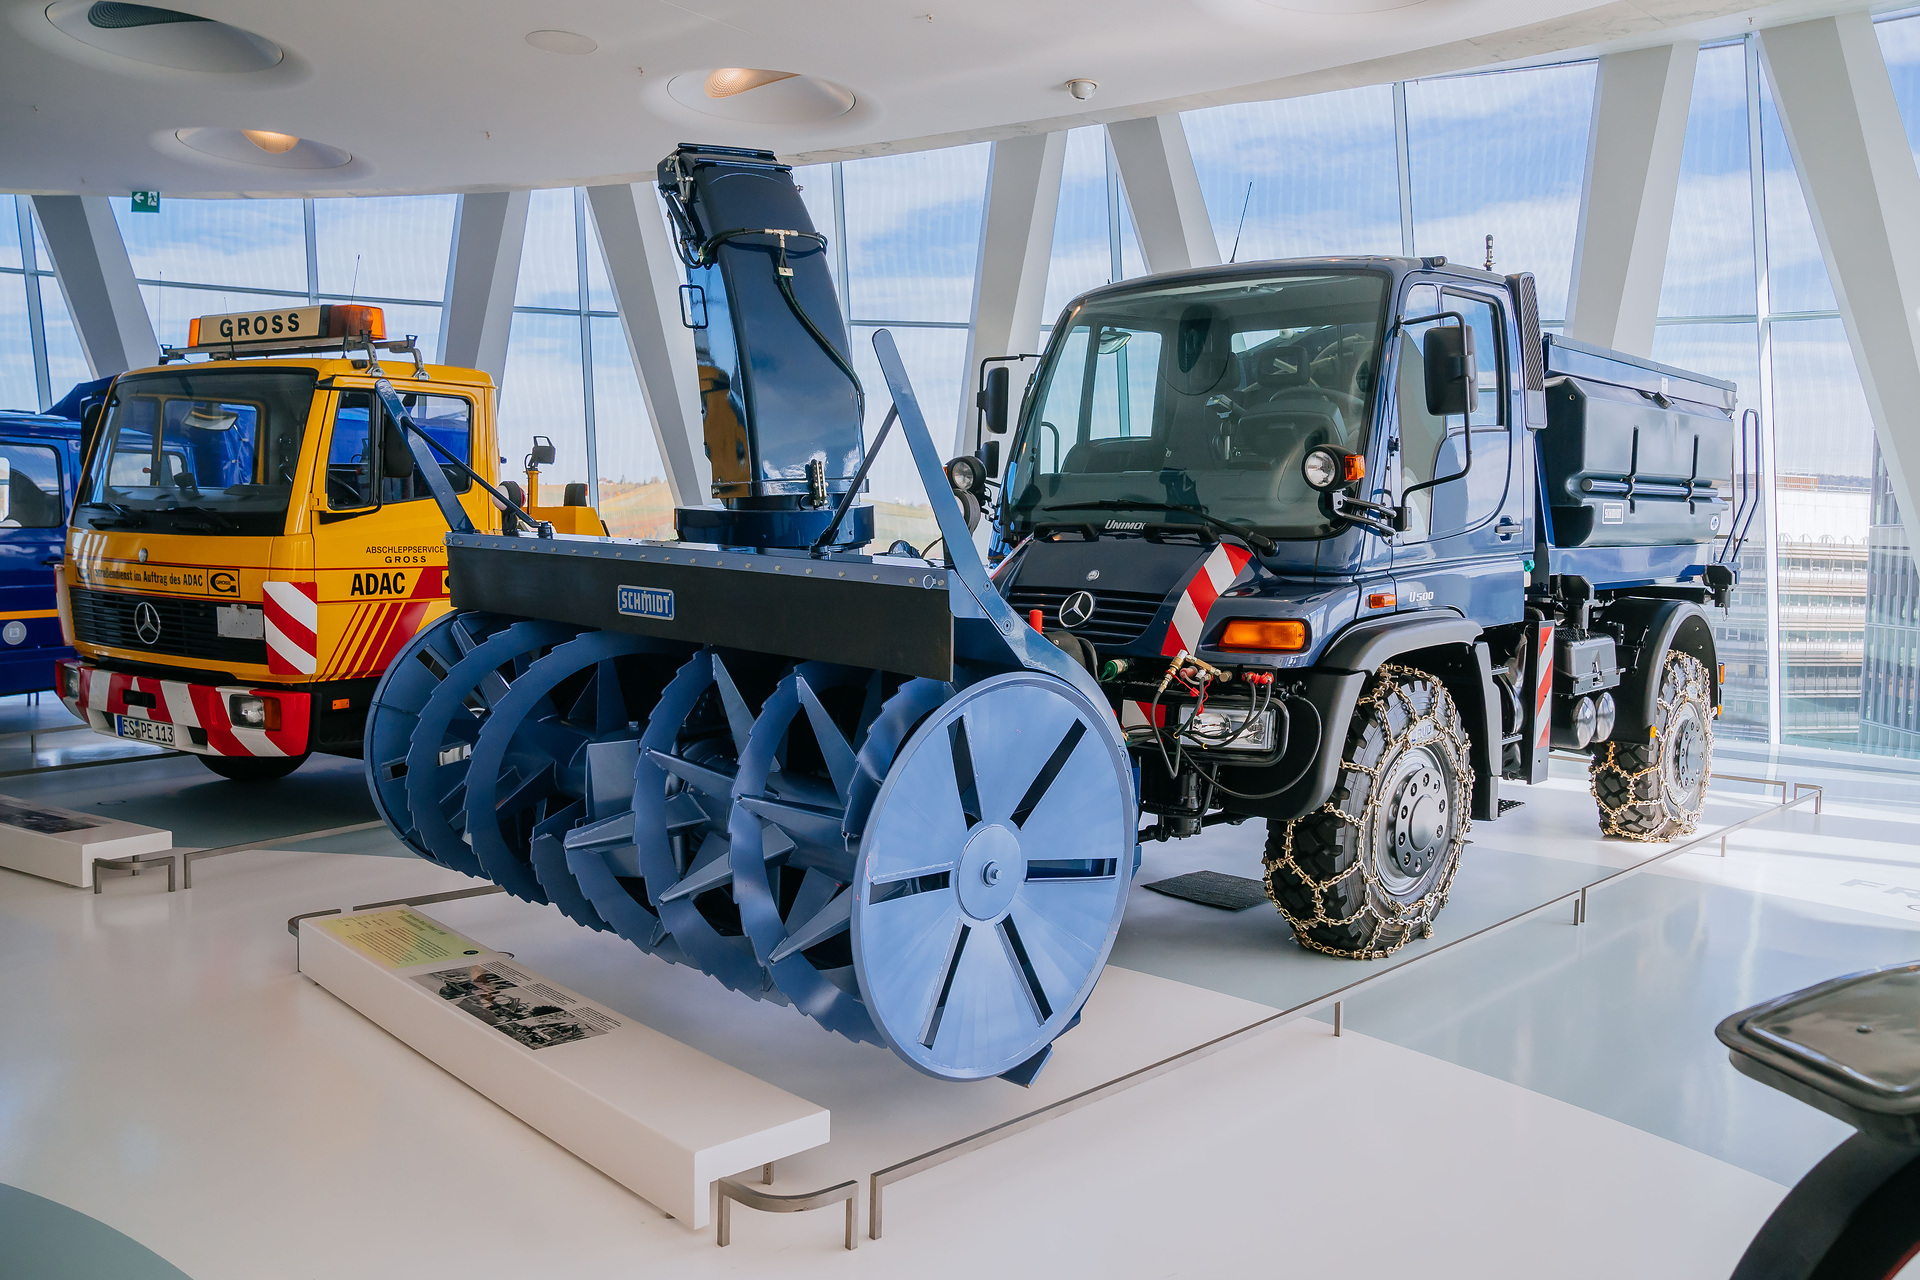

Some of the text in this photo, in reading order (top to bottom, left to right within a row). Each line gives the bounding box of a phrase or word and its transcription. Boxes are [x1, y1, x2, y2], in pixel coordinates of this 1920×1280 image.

[219, 312, 300, 338] GROSS
[365, 545, 445, 554] ABSCHLEPPSERVICE
[384, 555, 427, 564] GROSS
[134, 569, 142, 581] im
[143, 570, 168, 586] Auftrag
[169, 572, 181, 585] des
[183, 573, 203, 587] ADAC
[350, 571, 406, 597] ADAC
[621, 590, 670, 614] SCHMIDT
[122, 719, 174, 743] ES PE 113
